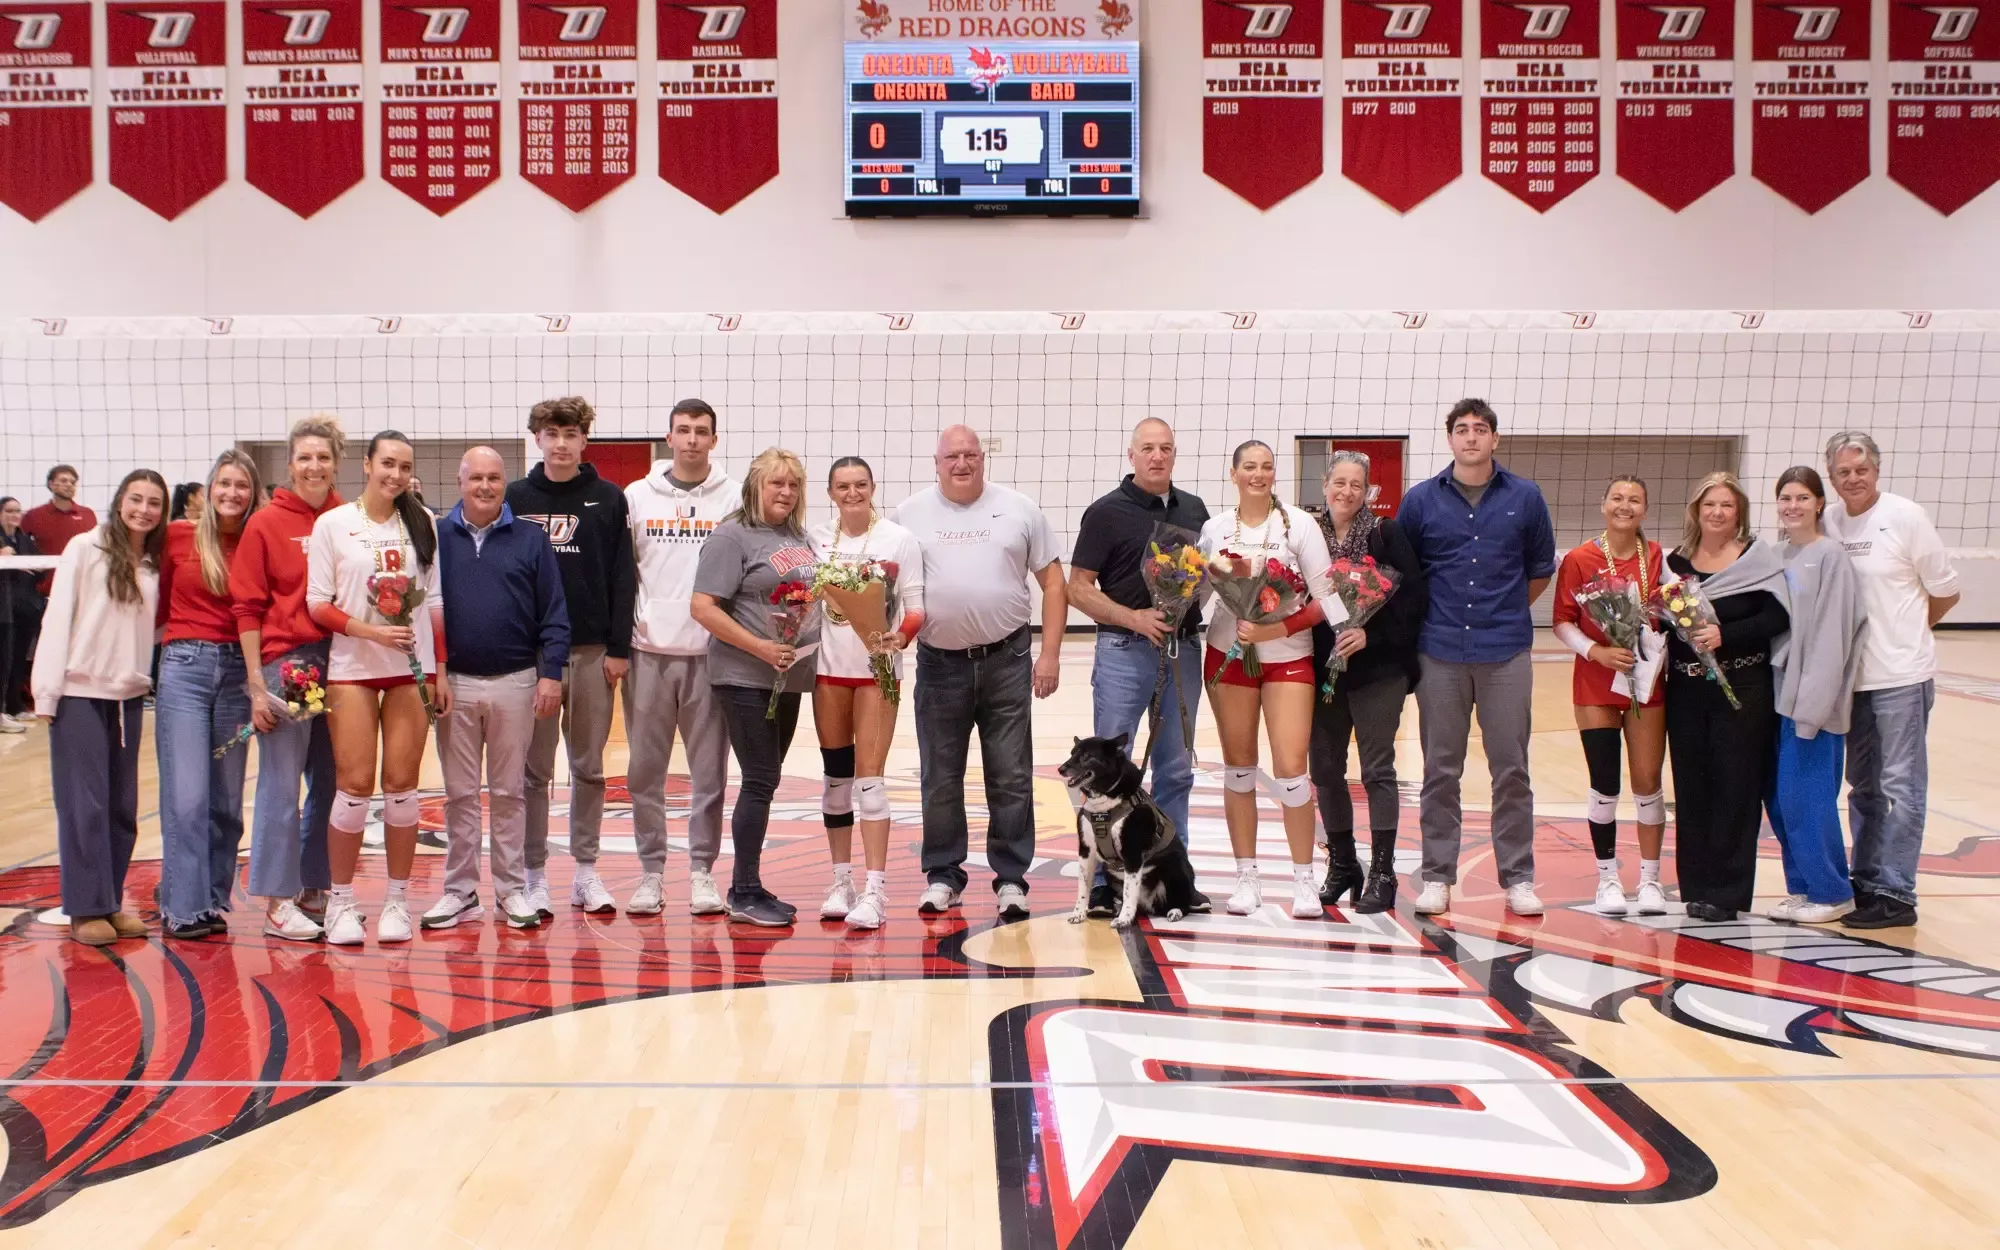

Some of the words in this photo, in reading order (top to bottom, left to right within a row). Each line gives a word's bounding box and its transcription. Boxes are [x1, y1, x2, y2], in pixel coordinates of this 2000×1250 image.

[928, 0, 990, 12] HOME
[993, 0, 1015, 12] OF
[1019, 0, 1056, 12] THE
[899, 17, 950, 37] RED
[959, 17, 1086, 37] DRAGONS
[247, 50, 293, 62] WOMEN'S
[296, 48, 359, 61] BASKETBALL
[388, 47, 418, 60] MEN'S
[420, 47, 454, 60] TRACK
[464, 47, 492, 59] FIELD
[520, 46, 547, 58] MEN'S
[548, 46, 596, 58] SWIMMING
[606, 46, 635, 57] DIVING
[692, 45, 742, 57] BASEBALL
[1211, 43, 1241, 55] MEN'S
[1243, 43, 1278, 55] TRACK
[1280, 44, 1286, 55] &
[1288, 43, 1316, 55] FIELD
[1354, 43, 1385, 55] MEN'S
[1387, 43, 1450, 55] BASKETBALL
[1498, 44, 1545, 56] WOMEN'S
[1547, 44, 1583, 56] SOCCER
[1636, 45, 1680, 57] WOMEN'S
[1682, 45, 1716, 57] SOCCER
[1778, 46, 1806, 58] FIELD
[1807, 46, 1846, 58] HOCKEY
[1924, 47, 1973, 59] SOFTBALL
[135, 52, 197, 65] VOLLEYBALL
[863, 54, 954, 76] ONEONTA
[1011, 53, 1128, 74] VOLLEYBALL
[416, 67, 464, 80] NCAA
[553, 65, 602, 79] NCAA
[693, 64, 742, 78] NCAA
[1239, 62, 1288, 76] NCAA
[1378, 62, 1426, 76] NCAA
[1516, 63, 1565, 77] NCAA
[1652, 64, 1701, 78] NCAA
[1787, 65, 1836, 79] NCAA
[1924, 65, 1972, 79] NCAA
[9, 71, 56, 86] NCAA
[143, 71, 190, 85] NCAA
[279, 69, 327, 83] NCAA
[246, 84, 360, 98] TOURNAMENT
[383, 84, 497, 97] TOURNAMENT
[520, 82, 635, 95] TOURNAMENT
[660, 80, 775, 94] TOURNAMENT
[873, 83, 947, 100] ONEONTA
[1030, 83, 1075, 100] BARD
[1206, 79, 1321, 92] TOURNAMENT
[1345, 79, 1459, 92] TOURNAMENT
[1484, 80, 1597, 93] TOURNAMENT
[1620, 81, 1732, 94] TOURNAMENT
[1755, 82, 1868, 95] TOURNAMENT
[110, 88, 223, 101] TOURNAMENT
[388, 106, 417, 120] 2005
[426, 106, 455, 120] 2007
[527, 104, 554, 117] 1964
[565, 104, 591, 117] 1965
[603, 104, 629, 117] 1966
[666, 104, 693, 117] 2010
[1212, 102, 1239, 115] 2019
[1352, 102, 1378, 115] 1977
[1389, 102, 1416, 115] 2010
[1490, 103, 1517, 116] 1997
[1564, 103, 1593, 116] 2000
[1625, 104, 1655, 117] 2013
[1666, 104, 1692, 117] 2015
[527, 119, 554, 131] 1967
[565, 119, 591, 131] 1970
[604, 119, 627, 131] 1971
[1490, 122, 1517, 135] 2001
[1527, 122, 1556, 135] 2002
[1564, 122, 1593, 135] 2003
[1898, 124, 1924, 137] 2014
[428, 125, 453, 139] 2010
[465, 125, 490, 139] 2011
[869, 123, 886, 148] 0
[1083, 122, 1099, 148] 0
[527, 133, 554, 146] 1972
[565, 133, 591, 146] 1973
[603, 133, 629, 146] 1974
[965, 128, 1008, 151] 1:15
[389, 145, 416, 158] 2012
[428, 145, 454, 158] 2013
[464, 145, 490, 158] 2014
[527, 147, 554, 160] 1975
[565, 147, 591, 160] 1976
[603, 147, 629, 160] 1977
[1489, 141, 1518, 154] 2004
[1527, 141, 1556, 154] 2005
[1564, 141, 1593, 154] 2006
[390, 164, 416, 177] 2015
[428, 164, 454, 177] 2016
[464, 164, 491, 177] 2017
[527, 162, 554, 174] 1978
[565, 162, 591, 174] 2012
[603, 162, 629, 174] 2013
[861, 164, 882, 173] SETS
[883, 164, 903, 173] WON
[985, 160, 1001, 171] SET
[1080, 164, 1100, 173] SETS
[1101, 163, 1121, 172] WON
[1489, 160, 1518, 173] 2007
[1527, 160, 1556, 173] 2008
[1564, 160, 1593, 173] 2009
[992, 174, 997, 184] 1
[428, 184, 454, 197] 2018
[880, 179, 889, 193] 0
[918, 180, 938, 193] TOL
[1044, 180, 1064, 193] TOL
[1101, 179, 1110, 193] 0
[1528, 180, 1554, 192] 2010
